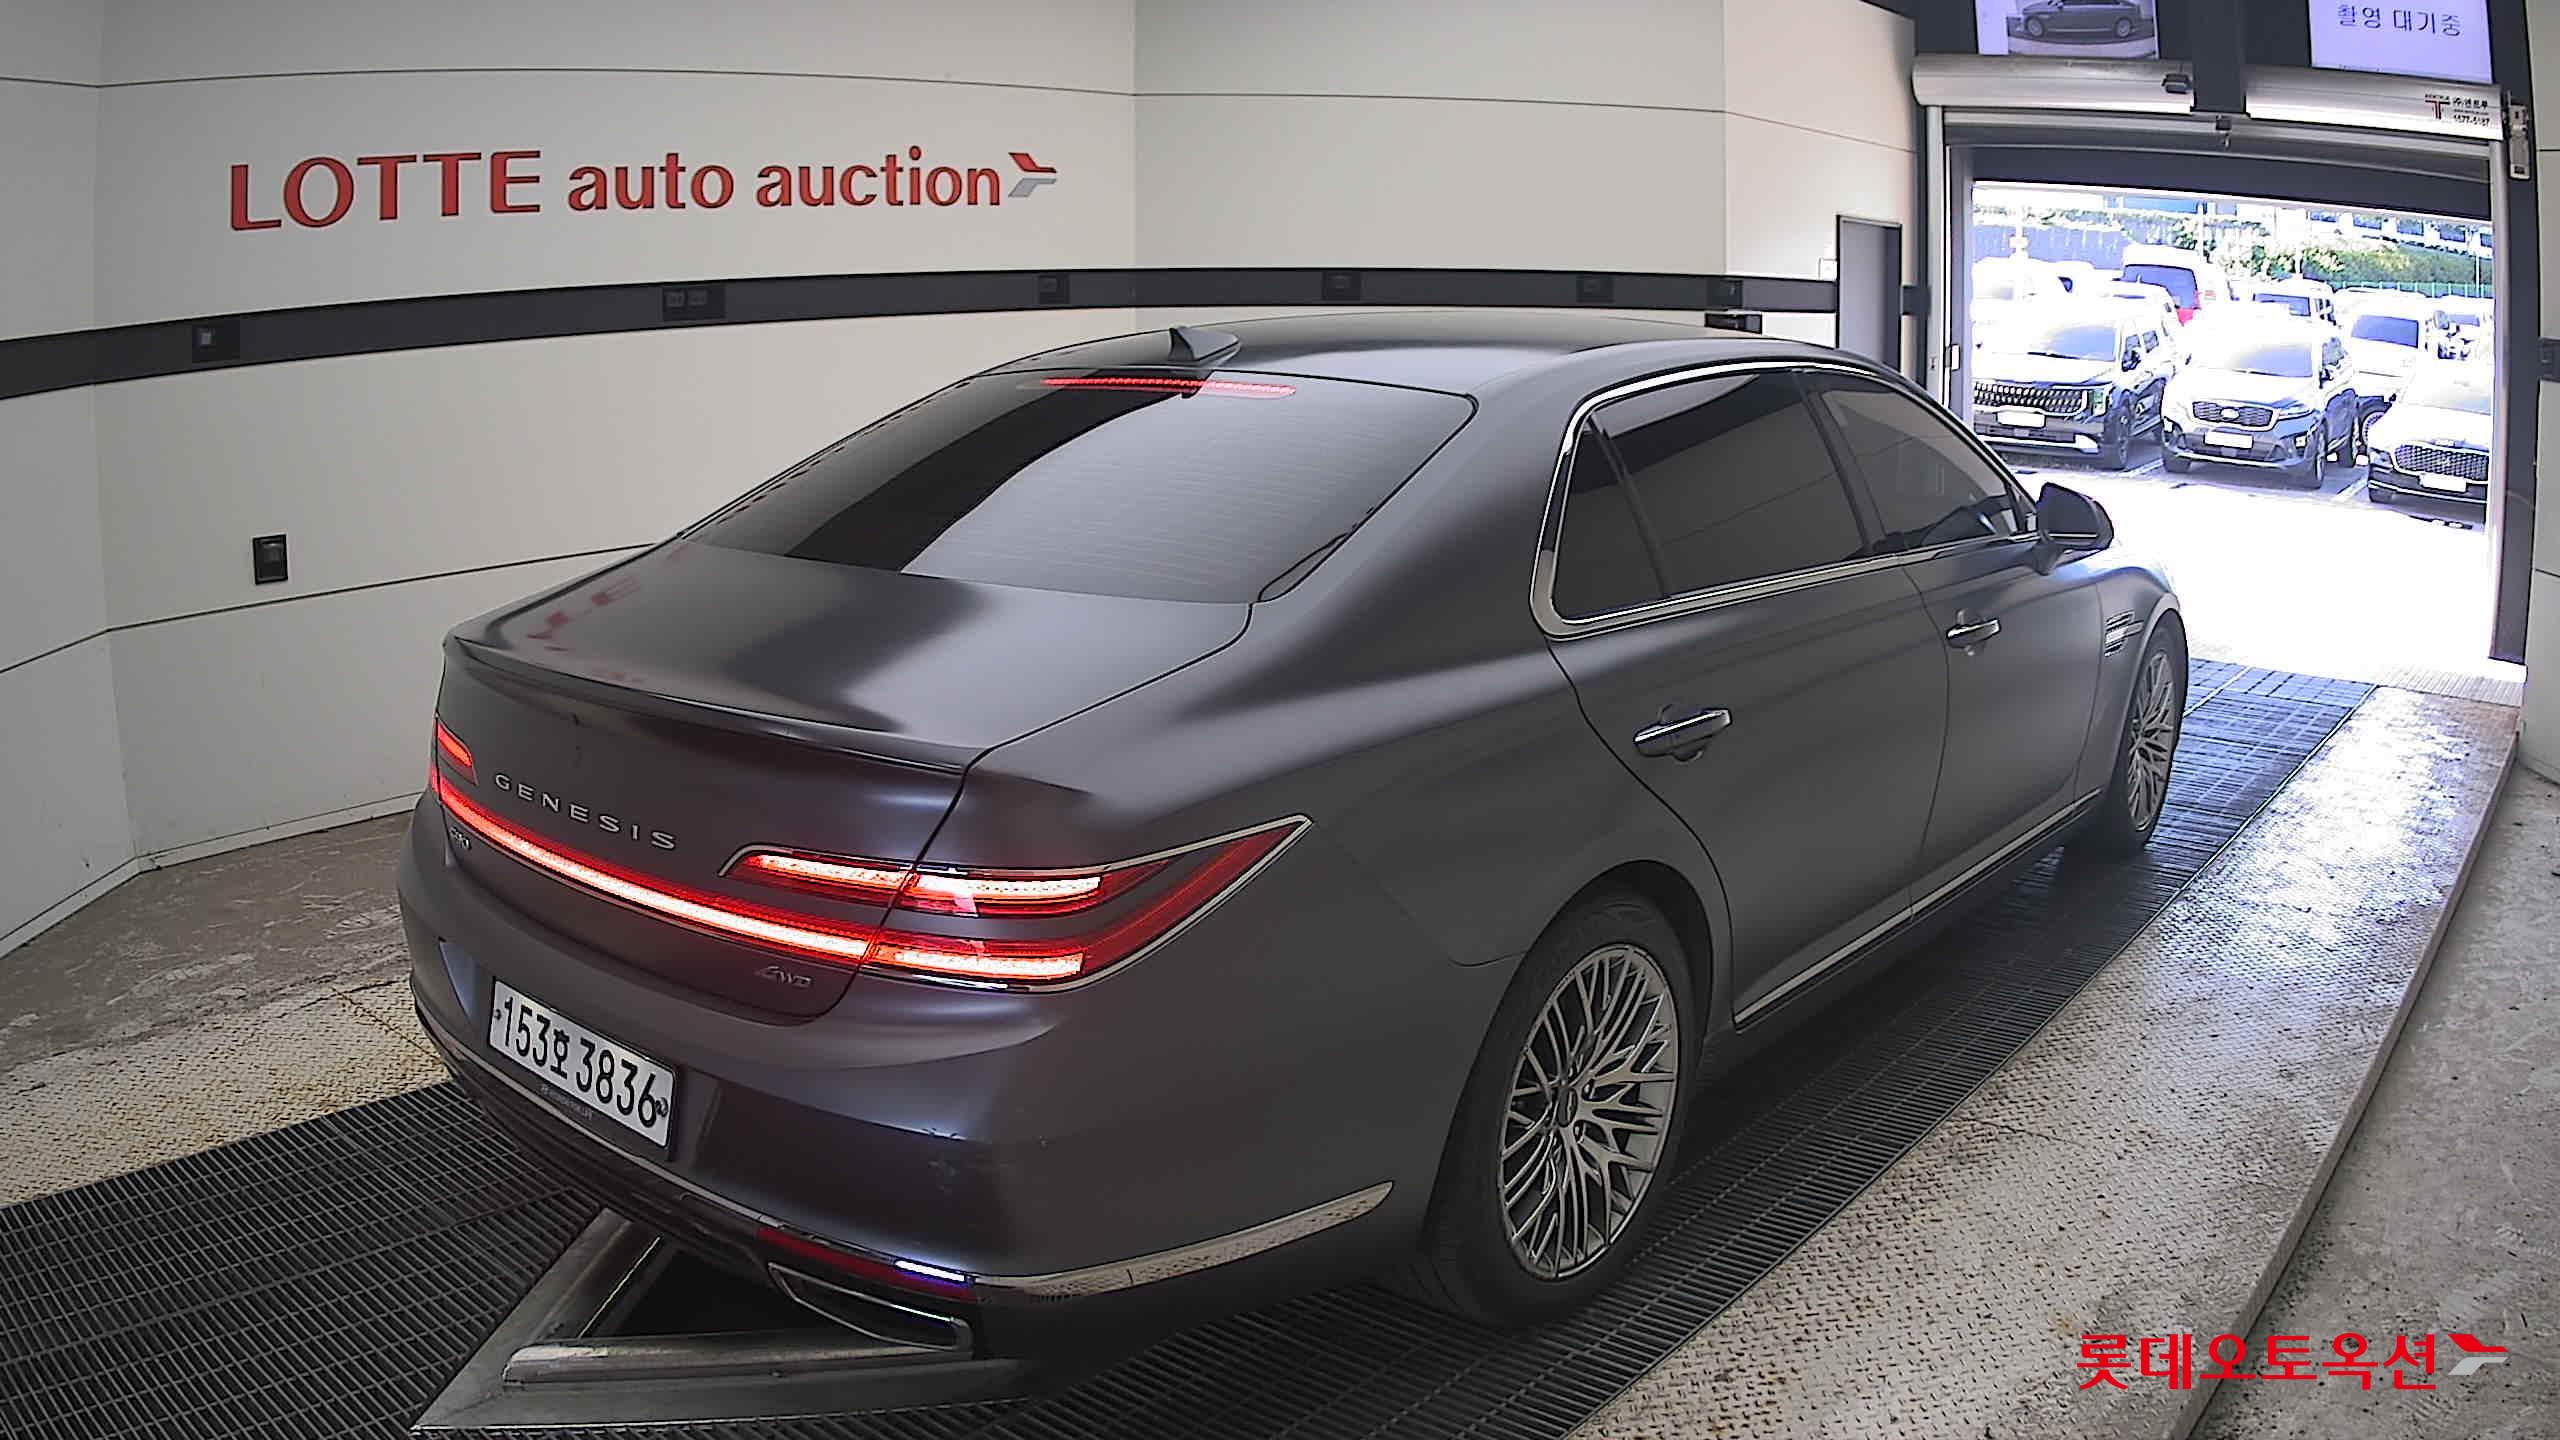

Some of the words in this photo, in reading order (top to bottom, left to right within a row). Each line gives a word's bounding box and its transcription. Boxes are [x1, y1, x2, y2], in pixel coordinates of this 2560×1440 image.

[2338, 4, 2382, 30] 촬영
[2392, 8, 2462, 38] 대기중
[230, 149, 541, 231] LOTTE
[567, 152, 735, 210] auto
[755, 146, 1002, 207] auction
[495, 773, 676, 851] GENESIS
[575, 1036, 657, 1129] 3836
